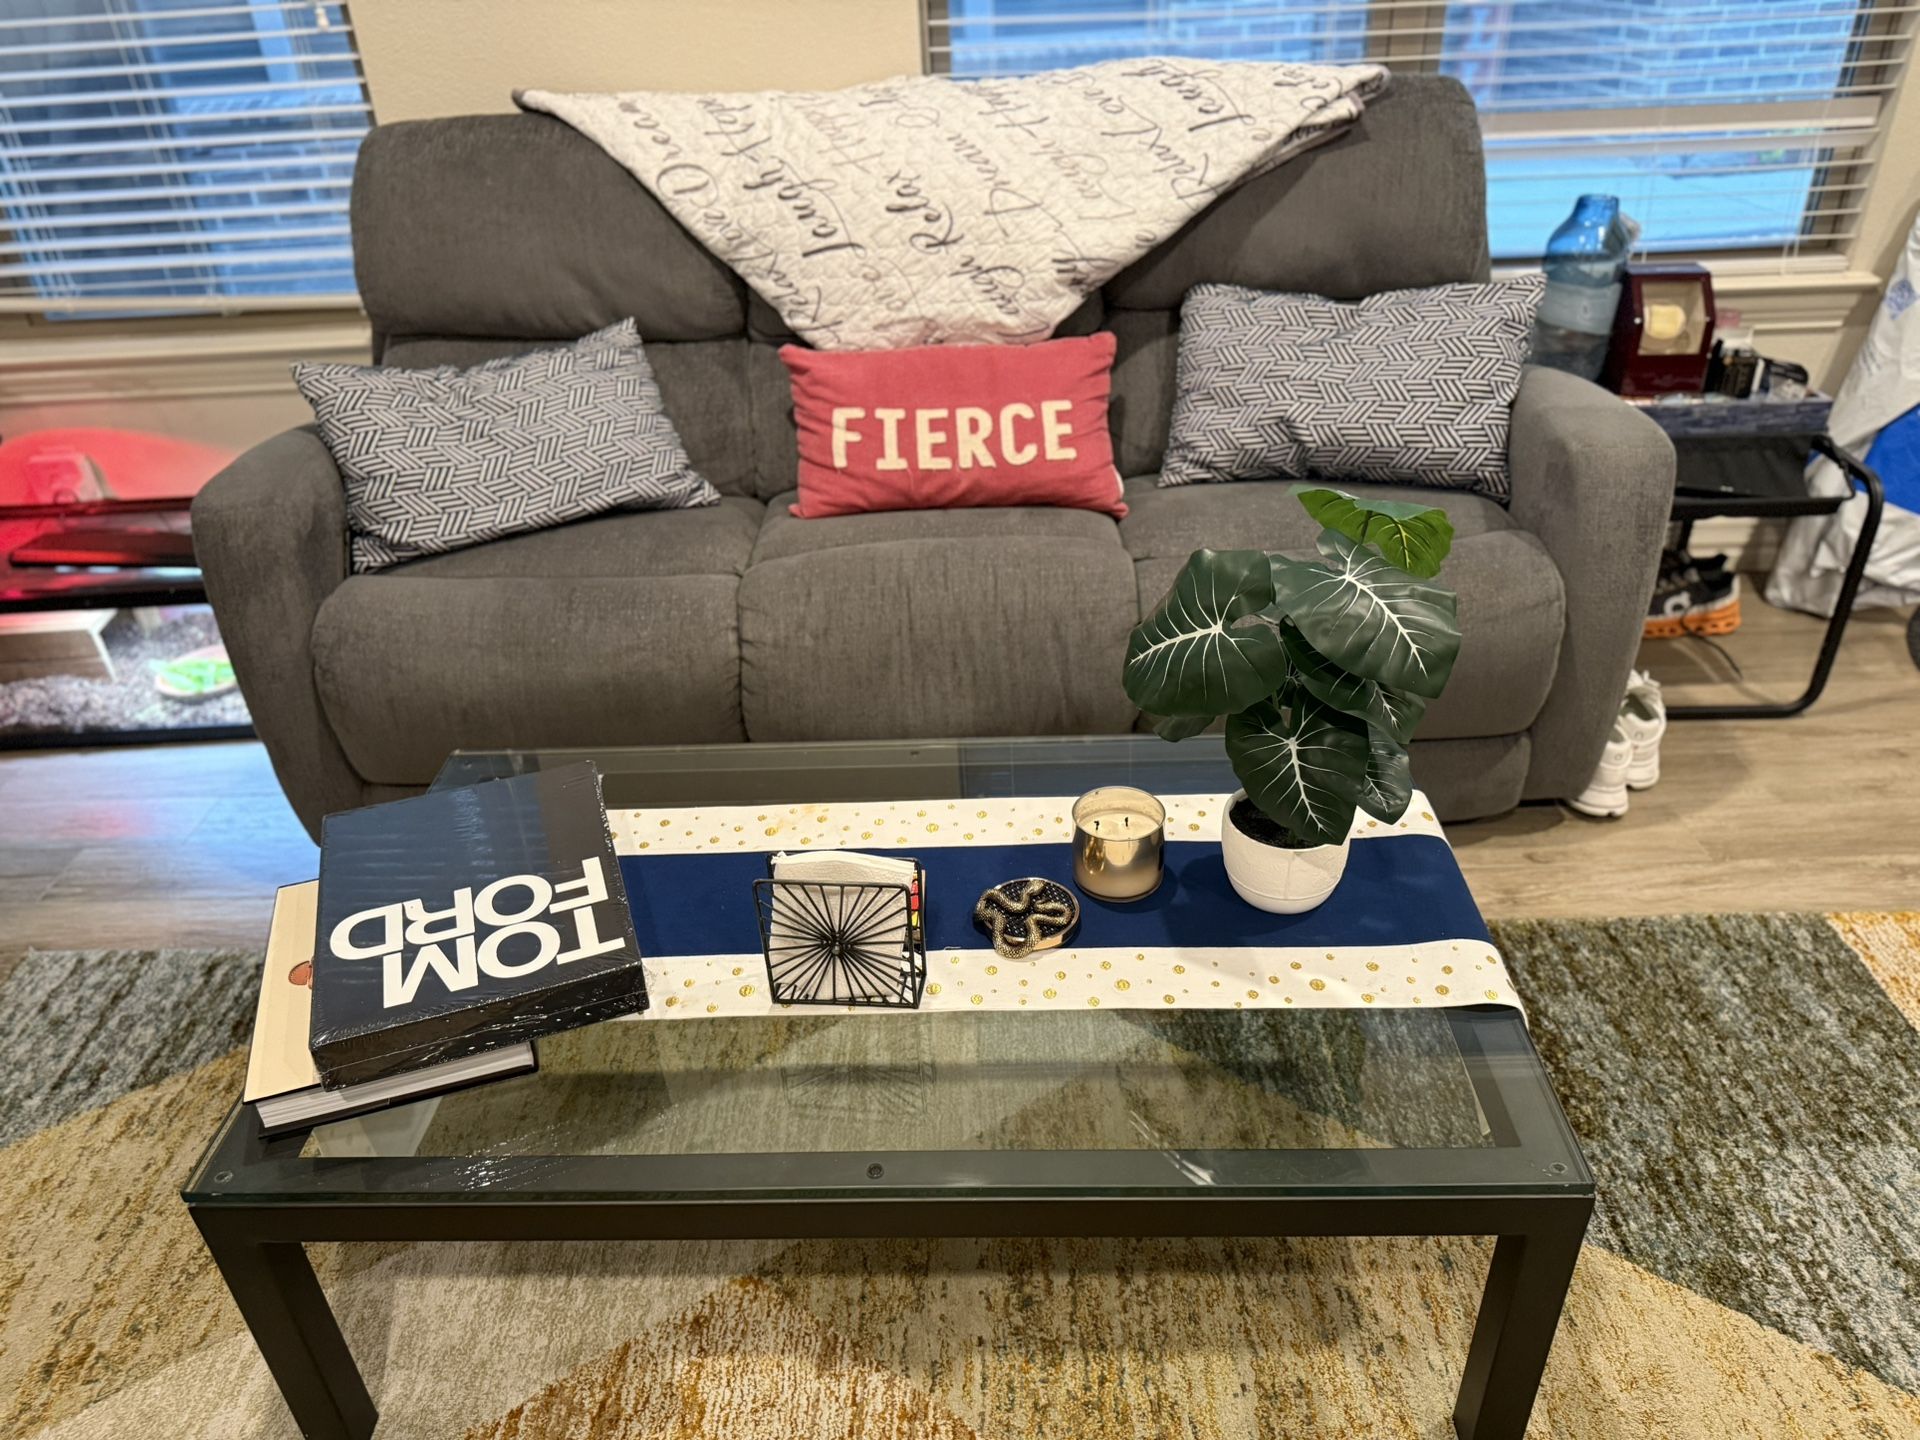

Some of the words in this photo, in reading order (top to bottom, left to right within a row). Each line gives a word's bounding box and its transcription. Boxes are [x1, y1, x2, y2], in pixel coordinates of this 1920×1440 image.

[743, 155, 867, 258] Laugh
[885, 169, 965, 255] Relax
[947, 134, 1062, 236] Dream
[1137, 128, 1231, 212] Relax
[949, 255, 1051, 340] Laugh
[831, 399, 1077, 470] FIERCE
[330, 856, 610, 960] FORD
[383, 906, 627, 1009] TOM
